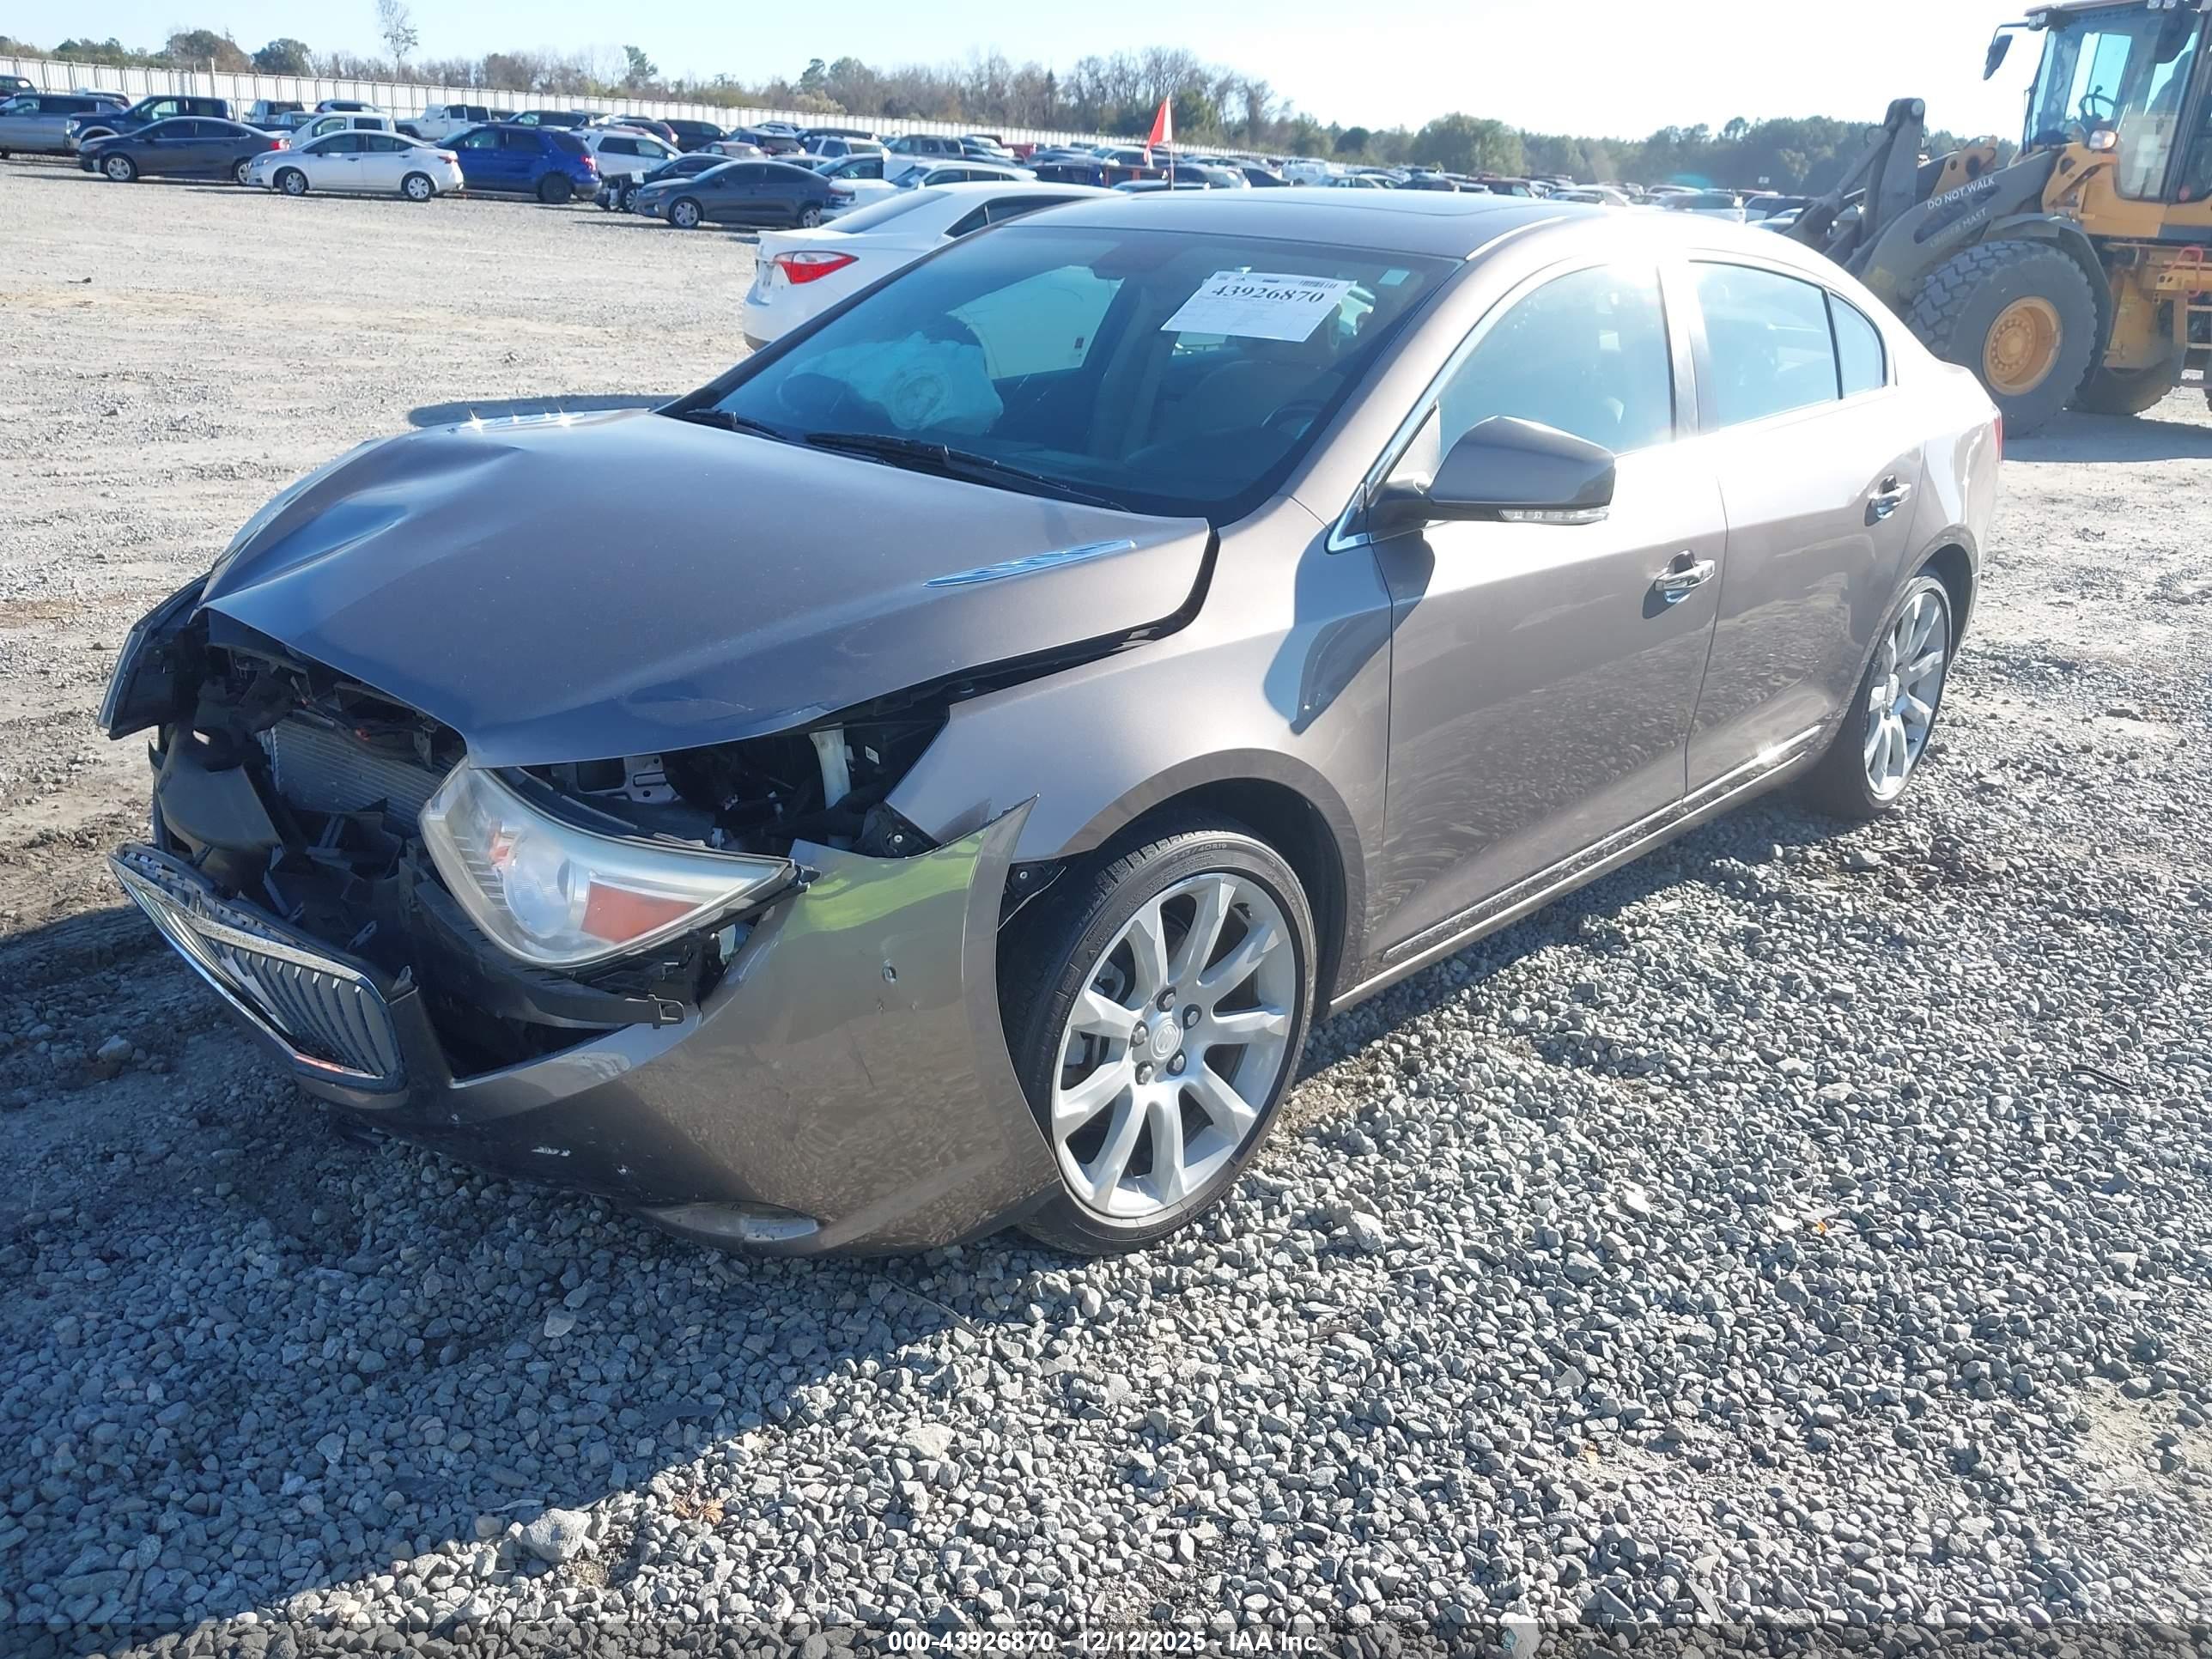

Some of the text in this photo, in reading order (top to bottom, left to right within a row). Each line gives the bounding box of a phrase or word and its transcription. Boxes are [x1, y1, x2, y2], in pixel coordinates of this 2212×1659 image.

[1927, 175, 1996, 210] DO NOT WALK
[1962, 208, 1986, 227] MAST
[1212, 284, 1325, 303] 43926870
